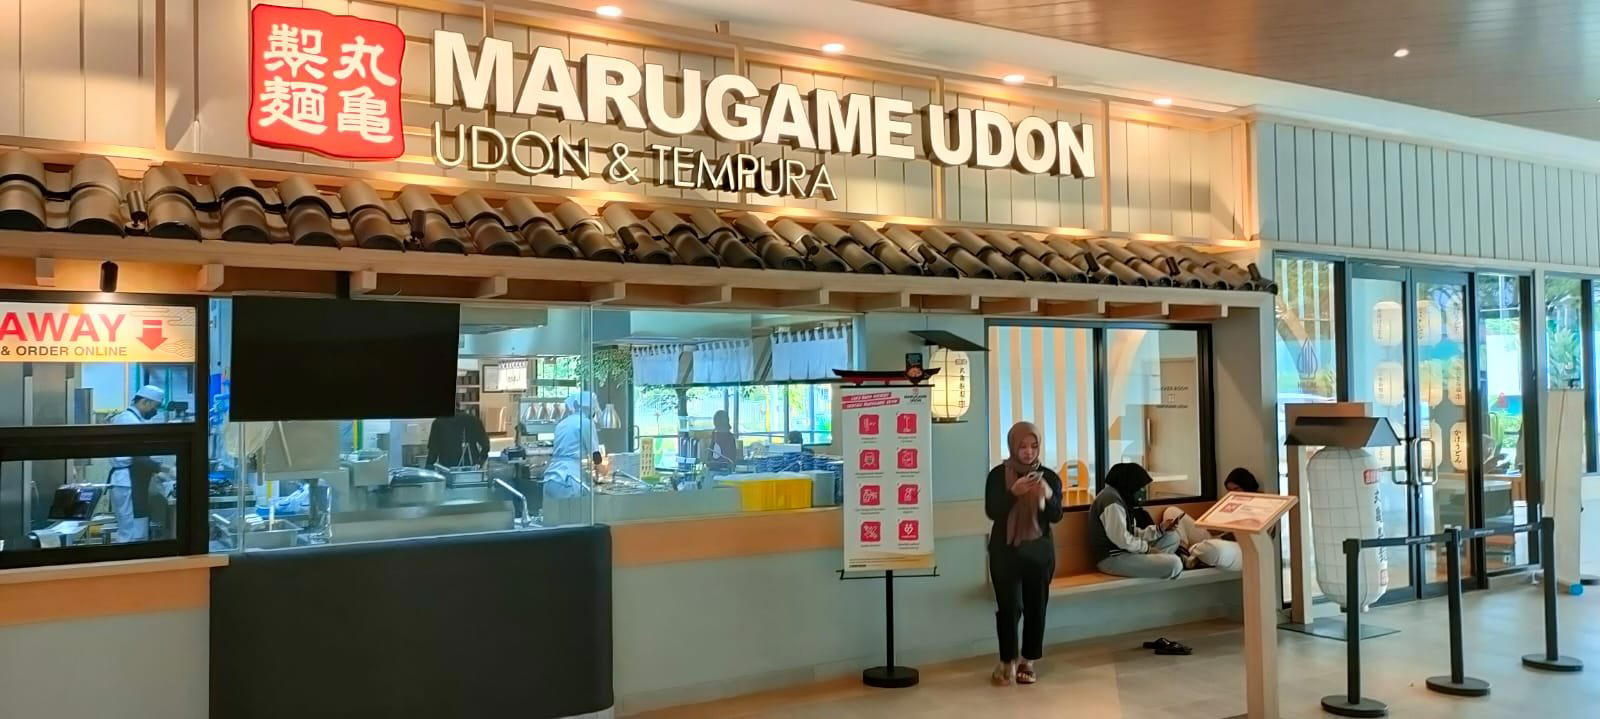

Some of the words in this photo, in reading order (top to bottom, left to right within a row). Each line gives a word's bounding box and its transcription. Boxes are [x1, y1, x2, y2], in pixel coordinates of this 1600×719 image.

[333, 35, 397, 143] 丸亀
[433, 29, 915, 160] MARUGAME
[923, 103, 1096, 179] UDON
[432, 121, 591, 179] UDON
[603, 142, 640, 184] &
[650, 143, 838, 200] TEMPURA
[0, 312, 126, 342] AWAY
[1, 345, 11, 356] &
[16, 346, 69, 356] ORDER
[74, 347, 128, 357] ONLINE
